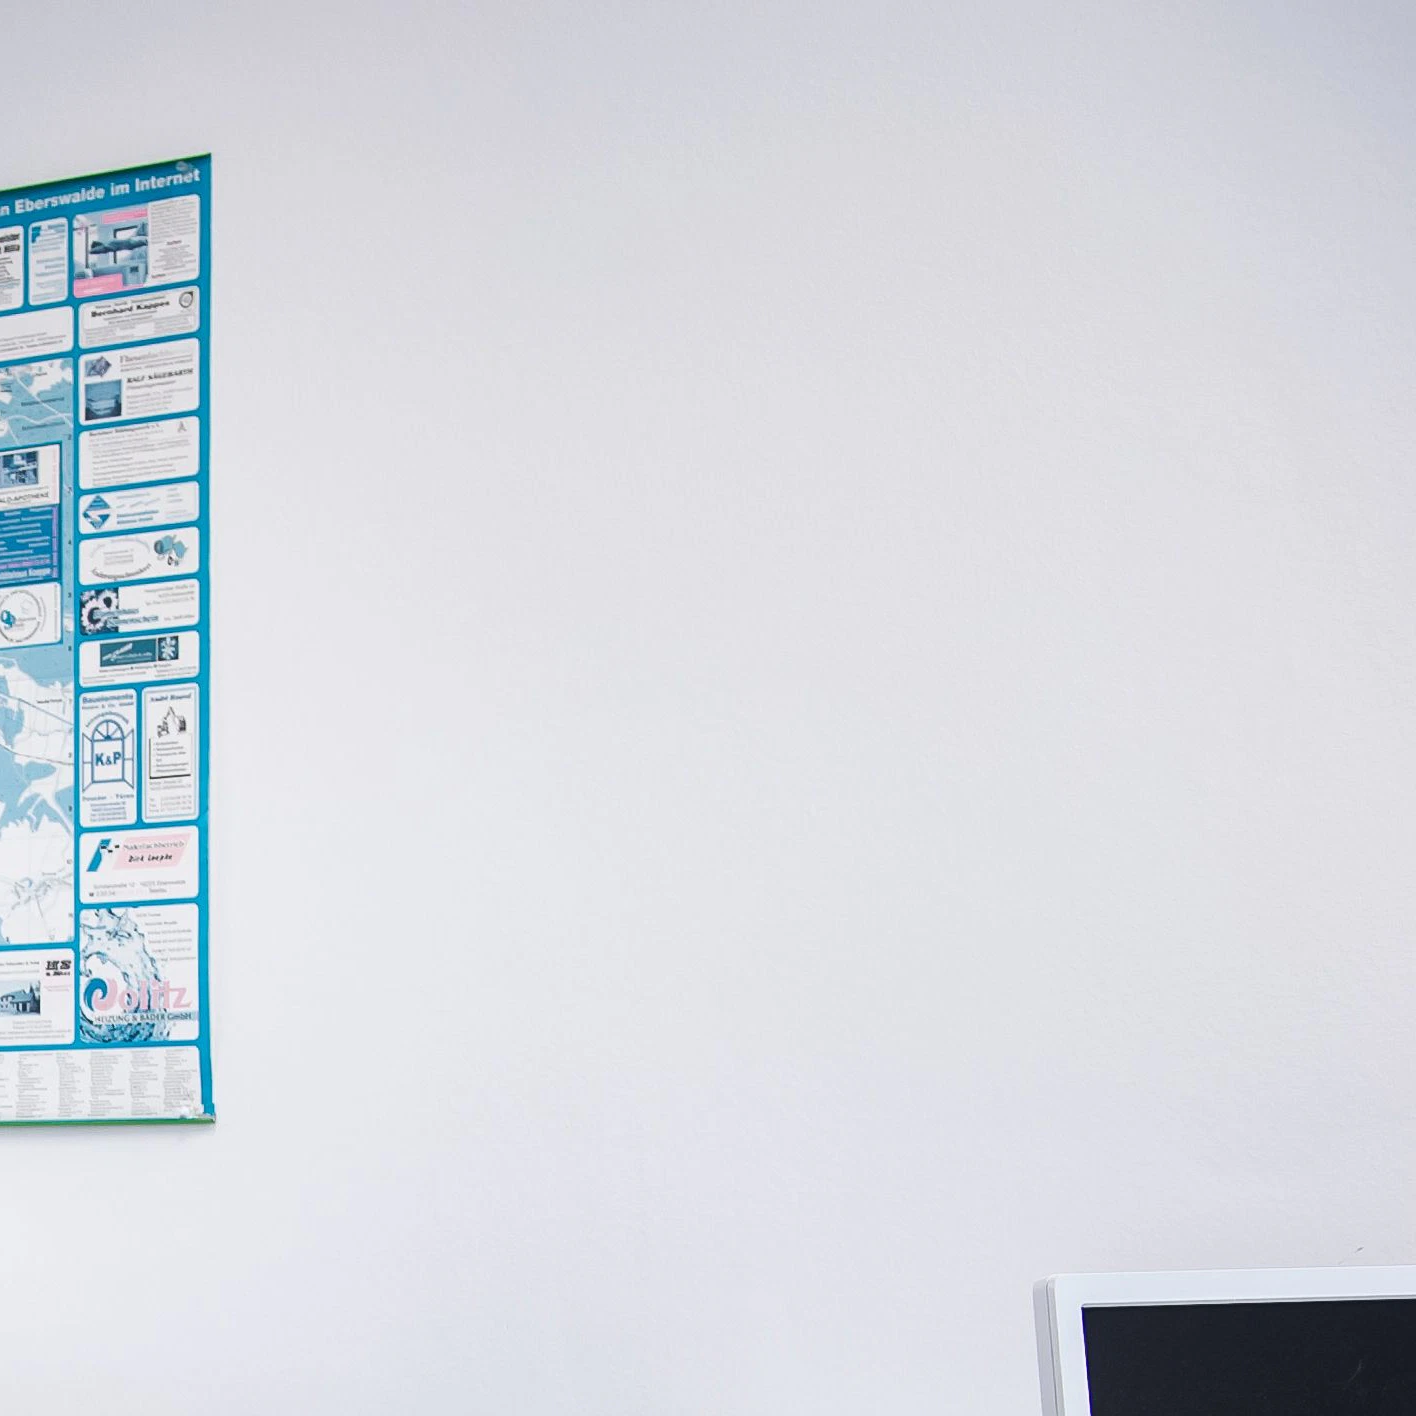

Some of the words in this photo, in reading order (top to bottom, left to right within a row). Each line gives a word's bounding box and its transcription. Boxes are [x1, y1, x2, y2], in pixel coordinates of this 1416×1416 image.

[14, 184, 105, 214] Eberswalde
[110, 182, 130, 197] im
[135, 168, 201, 194] Internet
[95, 751, 122, 767] K&P
